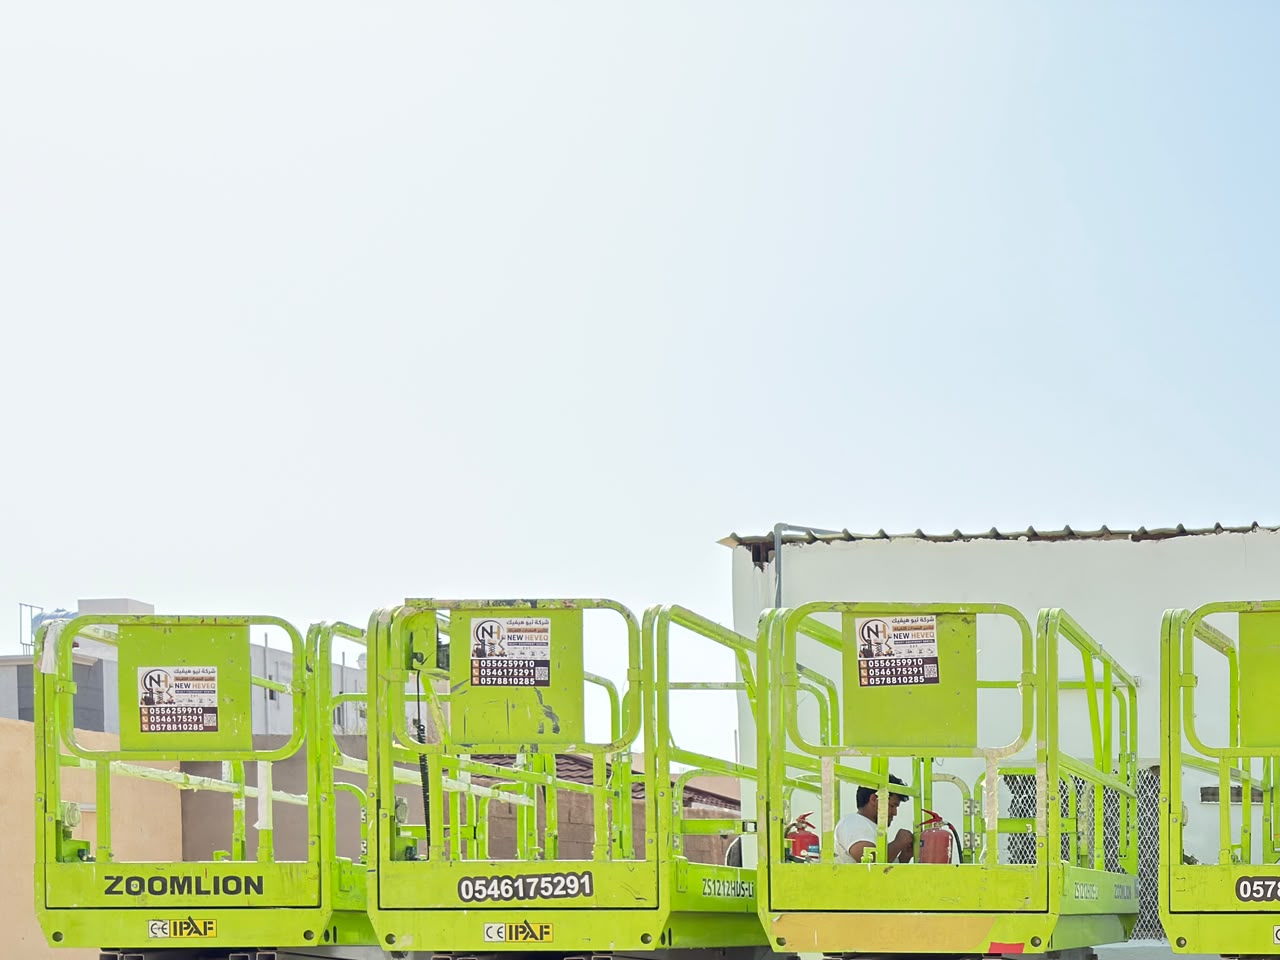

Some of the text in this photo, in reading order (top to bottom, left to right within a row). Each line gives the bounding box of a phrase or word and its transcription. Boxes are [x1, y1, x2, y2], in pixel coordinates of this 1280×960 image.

[893, 632, 910, 640] NEW
[868, 659, 923, 667] 0556259910
[869, 667, 923, 675] 0546175291
[869, 676, 925, 684] 0578810285
[104, 875, 264, 896] ZOOMLION
[461, 874, 591, 899] 0546175291
[150, 916, 214, 937] CE IPAF
[486, 919, 550, 941] CE IPAF
